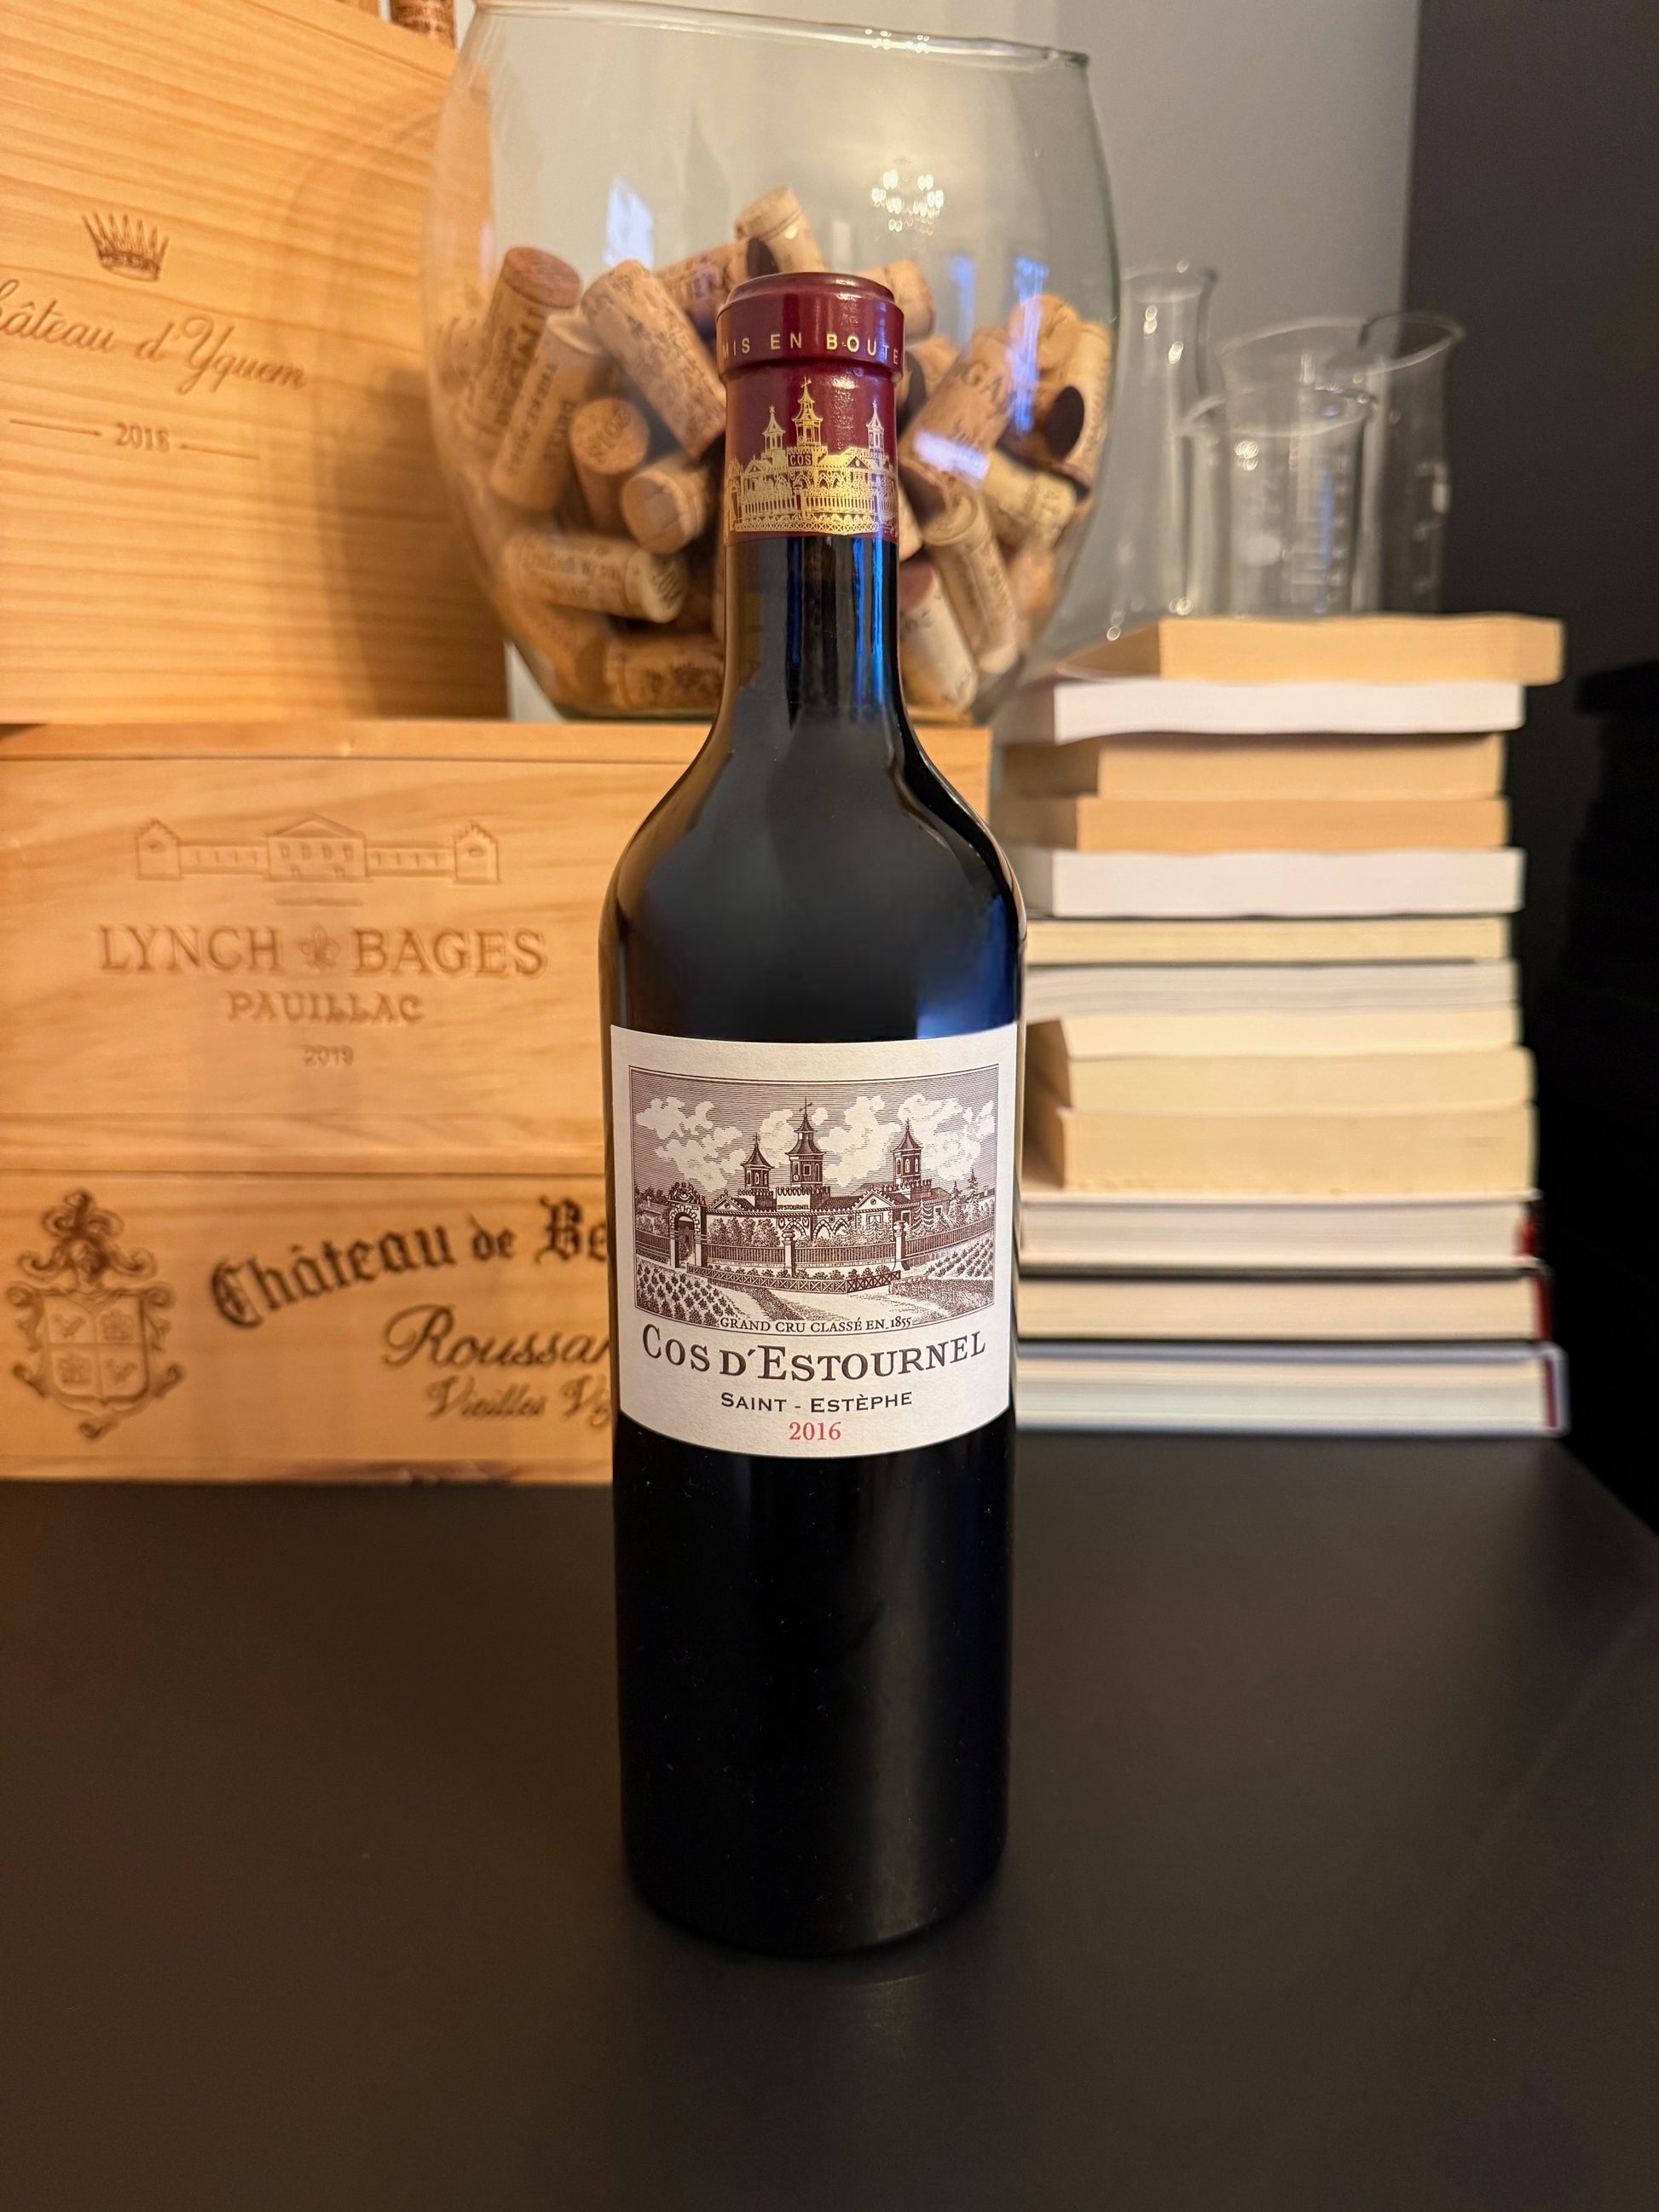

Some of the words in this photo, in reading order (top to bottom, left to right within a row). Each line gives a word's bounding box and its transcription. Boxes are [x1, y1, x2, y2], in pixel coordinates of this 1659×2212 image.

[134, 314, 308, 395] d'Yquem
[771, 332, 802, 350] EN
[826, 332, 899, 365] BOUTE
[114, 421, 171, 453] 2018
[789, 454, 812, 466] COS
[98, 924, 283, 974] LYNCH
[353, 927, 548, 979] BAGES
[226, 990, 425, 1025] PAUILLAC
[210, 1225, 455, 1328] Château
[468, 1214, 516, 1261] de
[720, 1317, 771, 1331] GRAND
[775, 1320, 806, 1333] CRU
[810, 1316, 862, 1332] CLASSÉ
[865, 1318, 885, 1331] EN
[890, 1315, 912, 1330] 1855
[642, 1323, 711, 1372] COS
[720, 1392, 787, 1412] SAINT
[810, 1391, 912, 1413] ESTÈPHE
[789, 1421, 842, 1441] 2016
